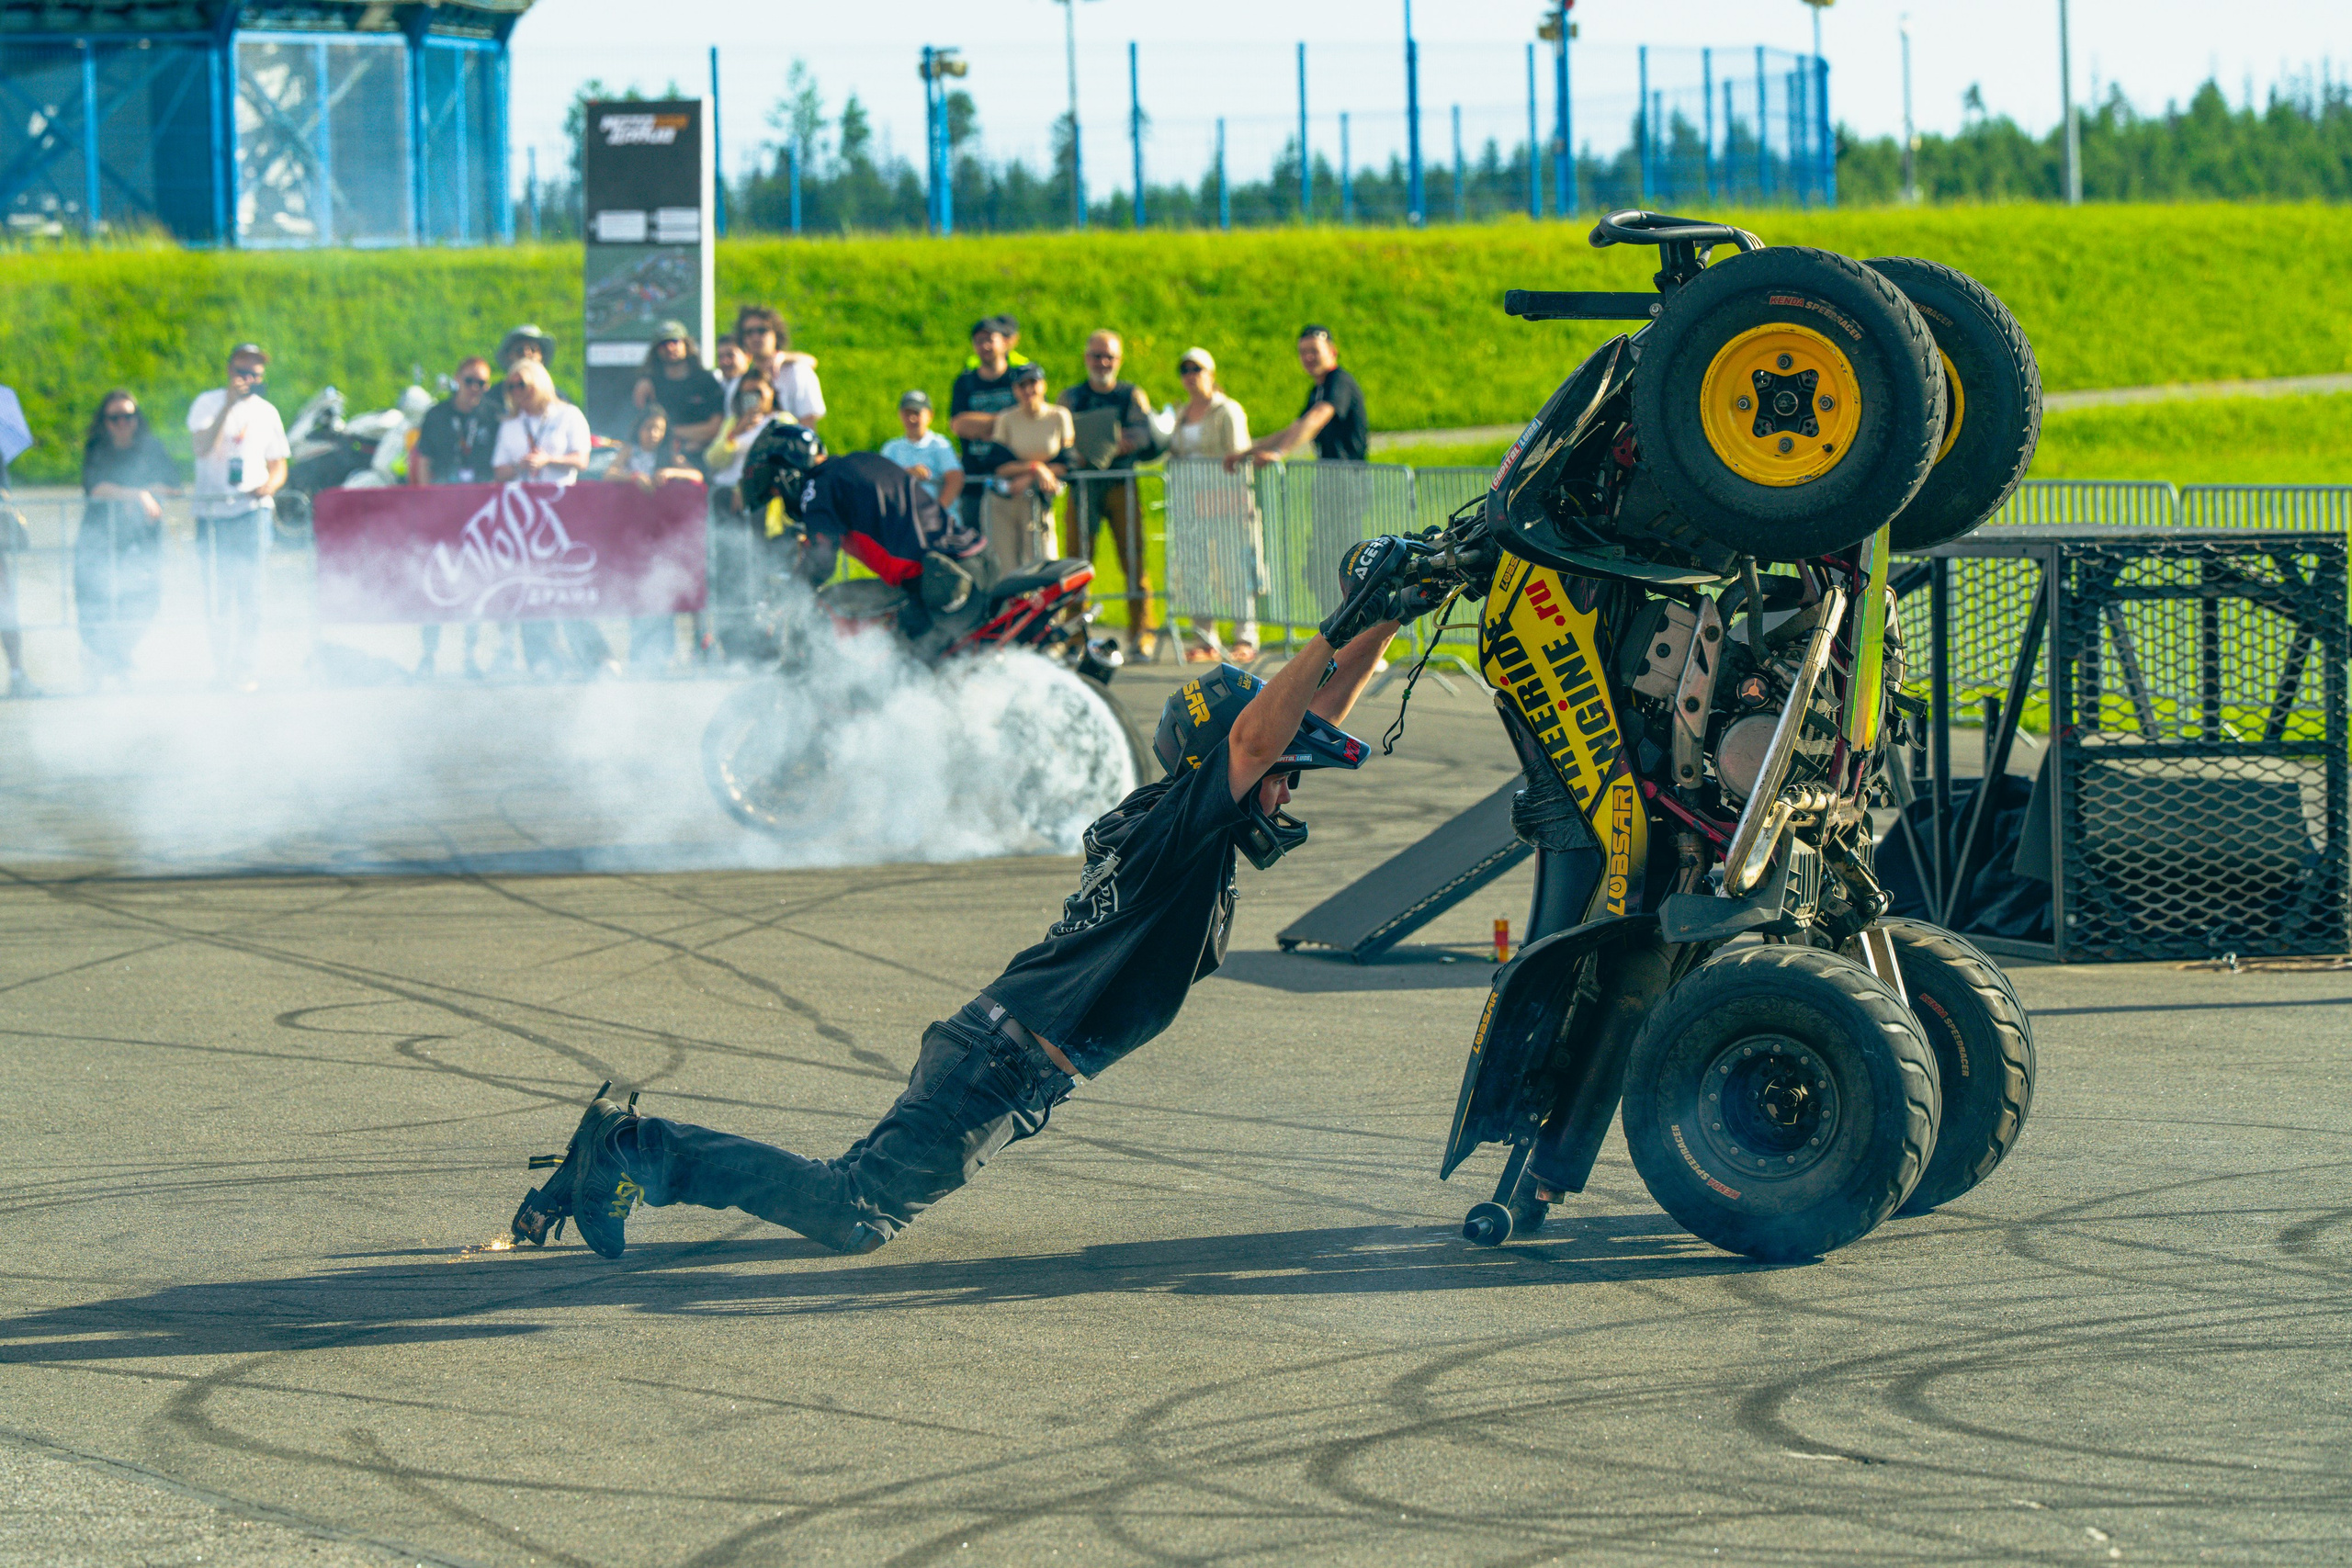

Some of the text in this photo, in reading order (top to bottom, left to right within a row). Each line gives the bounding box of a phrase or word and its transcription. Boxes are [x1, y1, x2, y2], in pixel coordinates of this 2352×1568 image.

[1770, 295, 1862, 342] KENDA SPEEDRACER
[1492, 420, 1540, 488] CAPITAL LUBE
[1500, 555, 1519, 591] LUBS
[1182, 679, 1211, 728] SAR
[1918, 992, 1970, 1077] KENDA SPEEDRACER
[1671, 1123, 1742, 1201] KENDA SPEEDRACER
